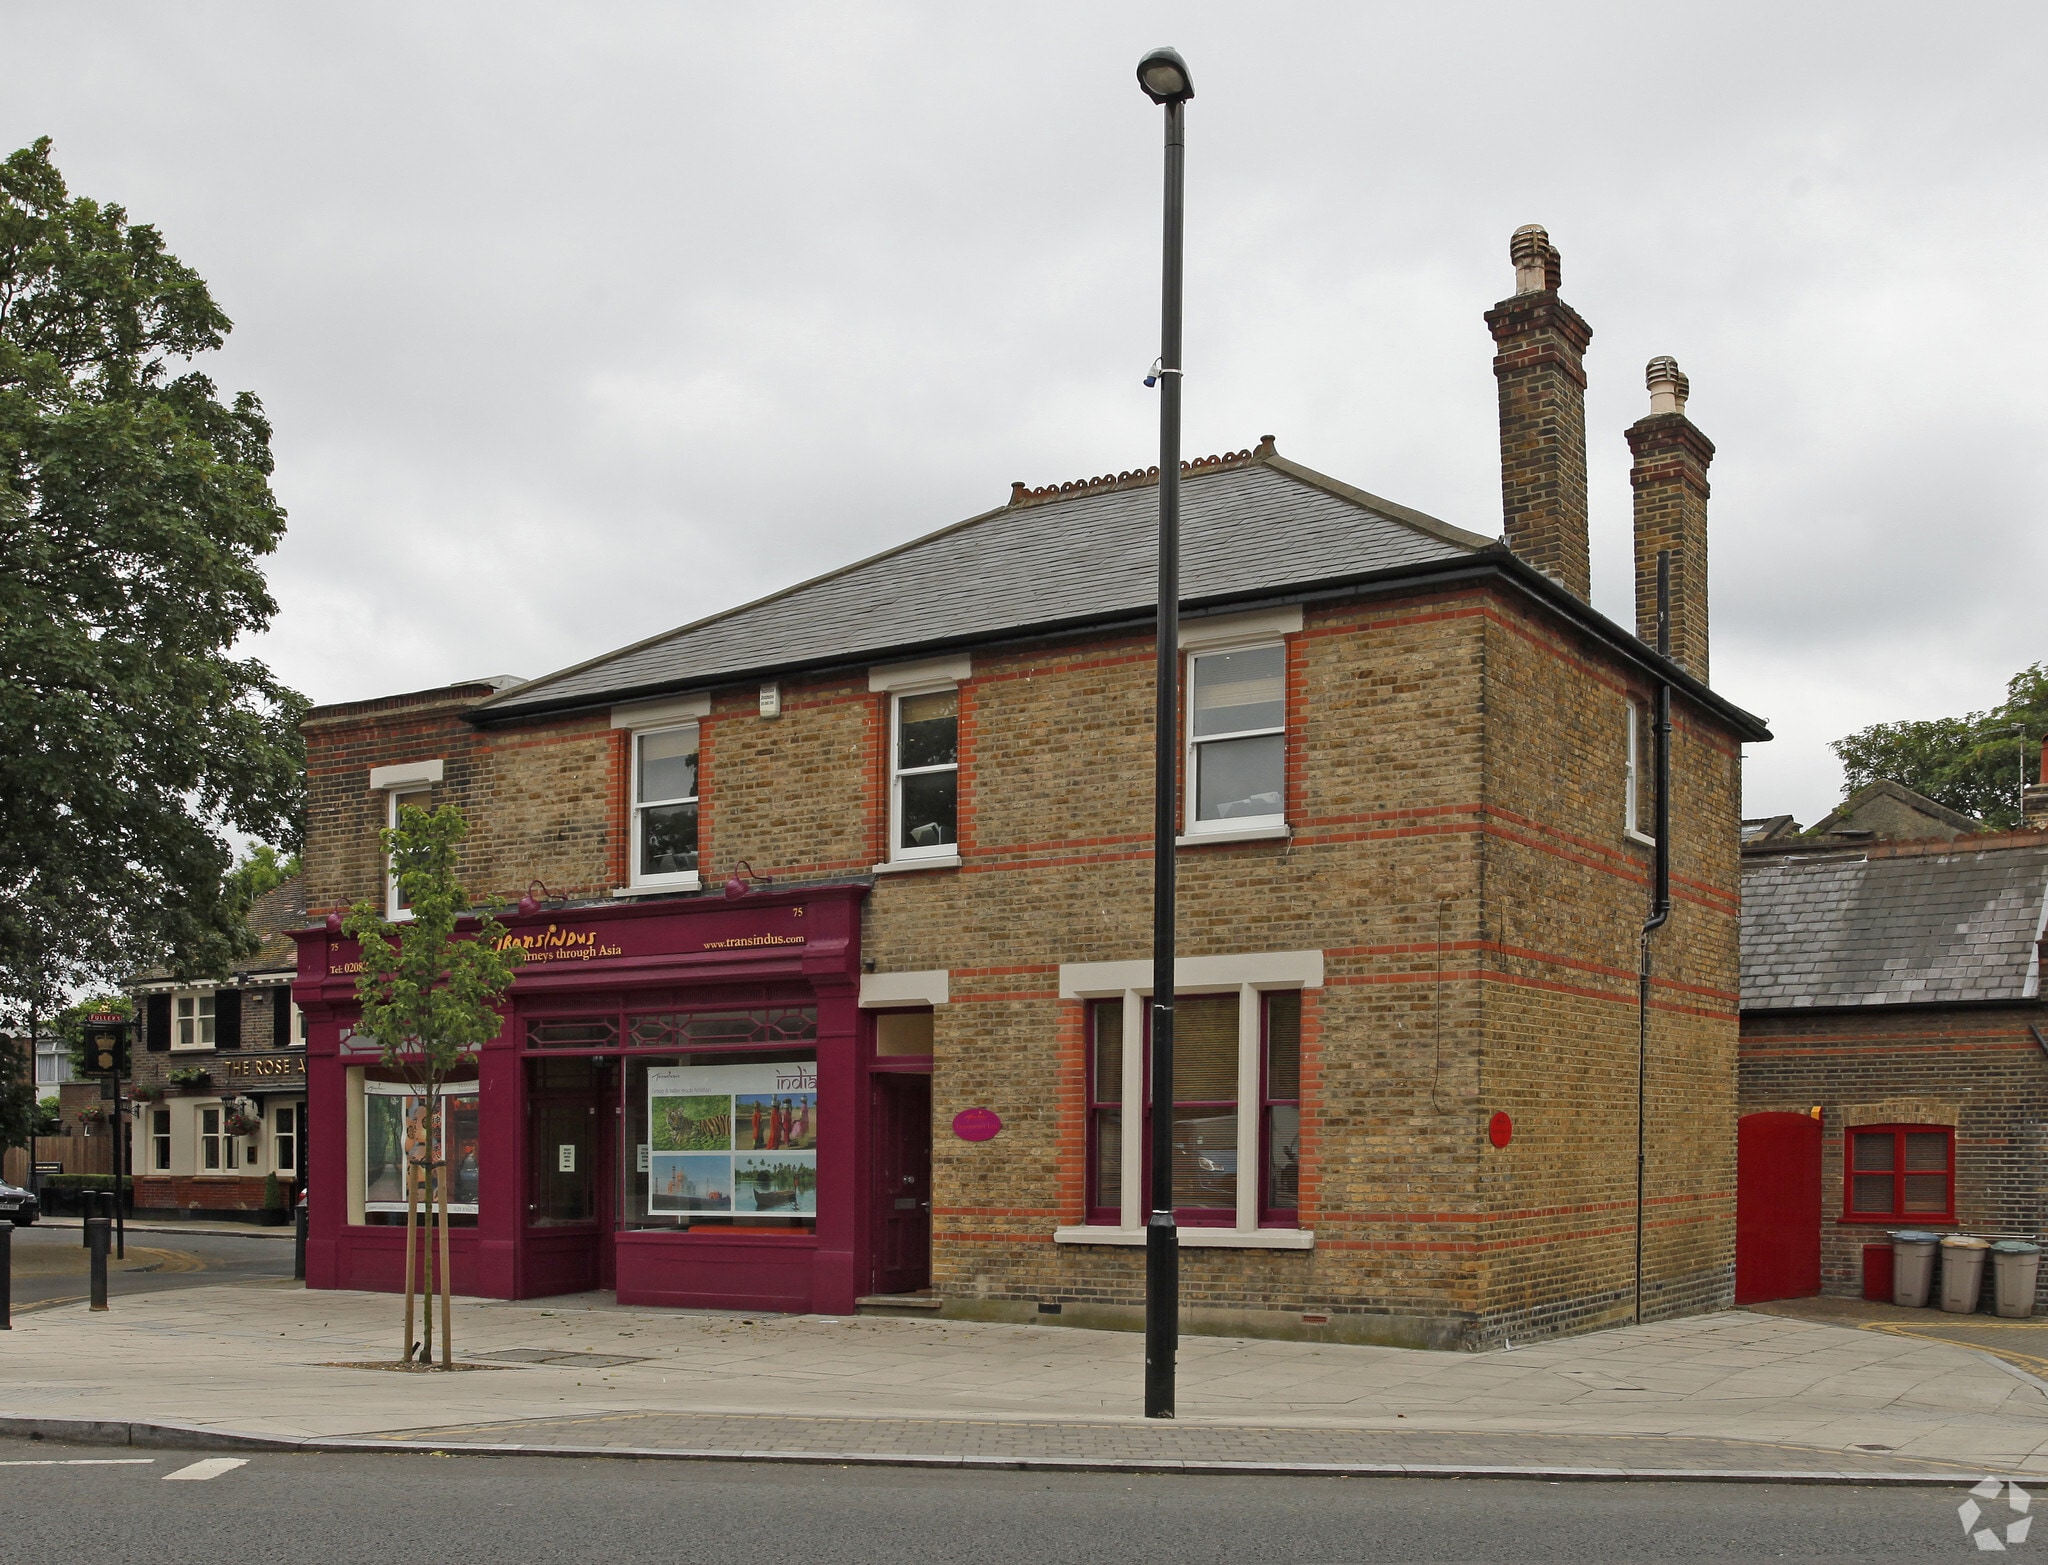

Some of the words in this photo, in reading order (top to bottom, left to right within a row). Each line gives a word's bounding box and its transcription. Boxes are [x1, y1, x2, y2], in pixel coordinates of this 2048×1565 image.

[793, 907, 804, 917] 75
[330, 943, 339, 951] 75
[703, 933, 805, 949] www.transindus.com
[556, 946, 596, 960] through
[599, 944, 622, 956] Asia
[344, 961, 369, 973] 0208
[225, 1060, 249, 1077] THE
[255, 1059, 290, 1076] ROSE
[776, 1065, 817, 1090] india
